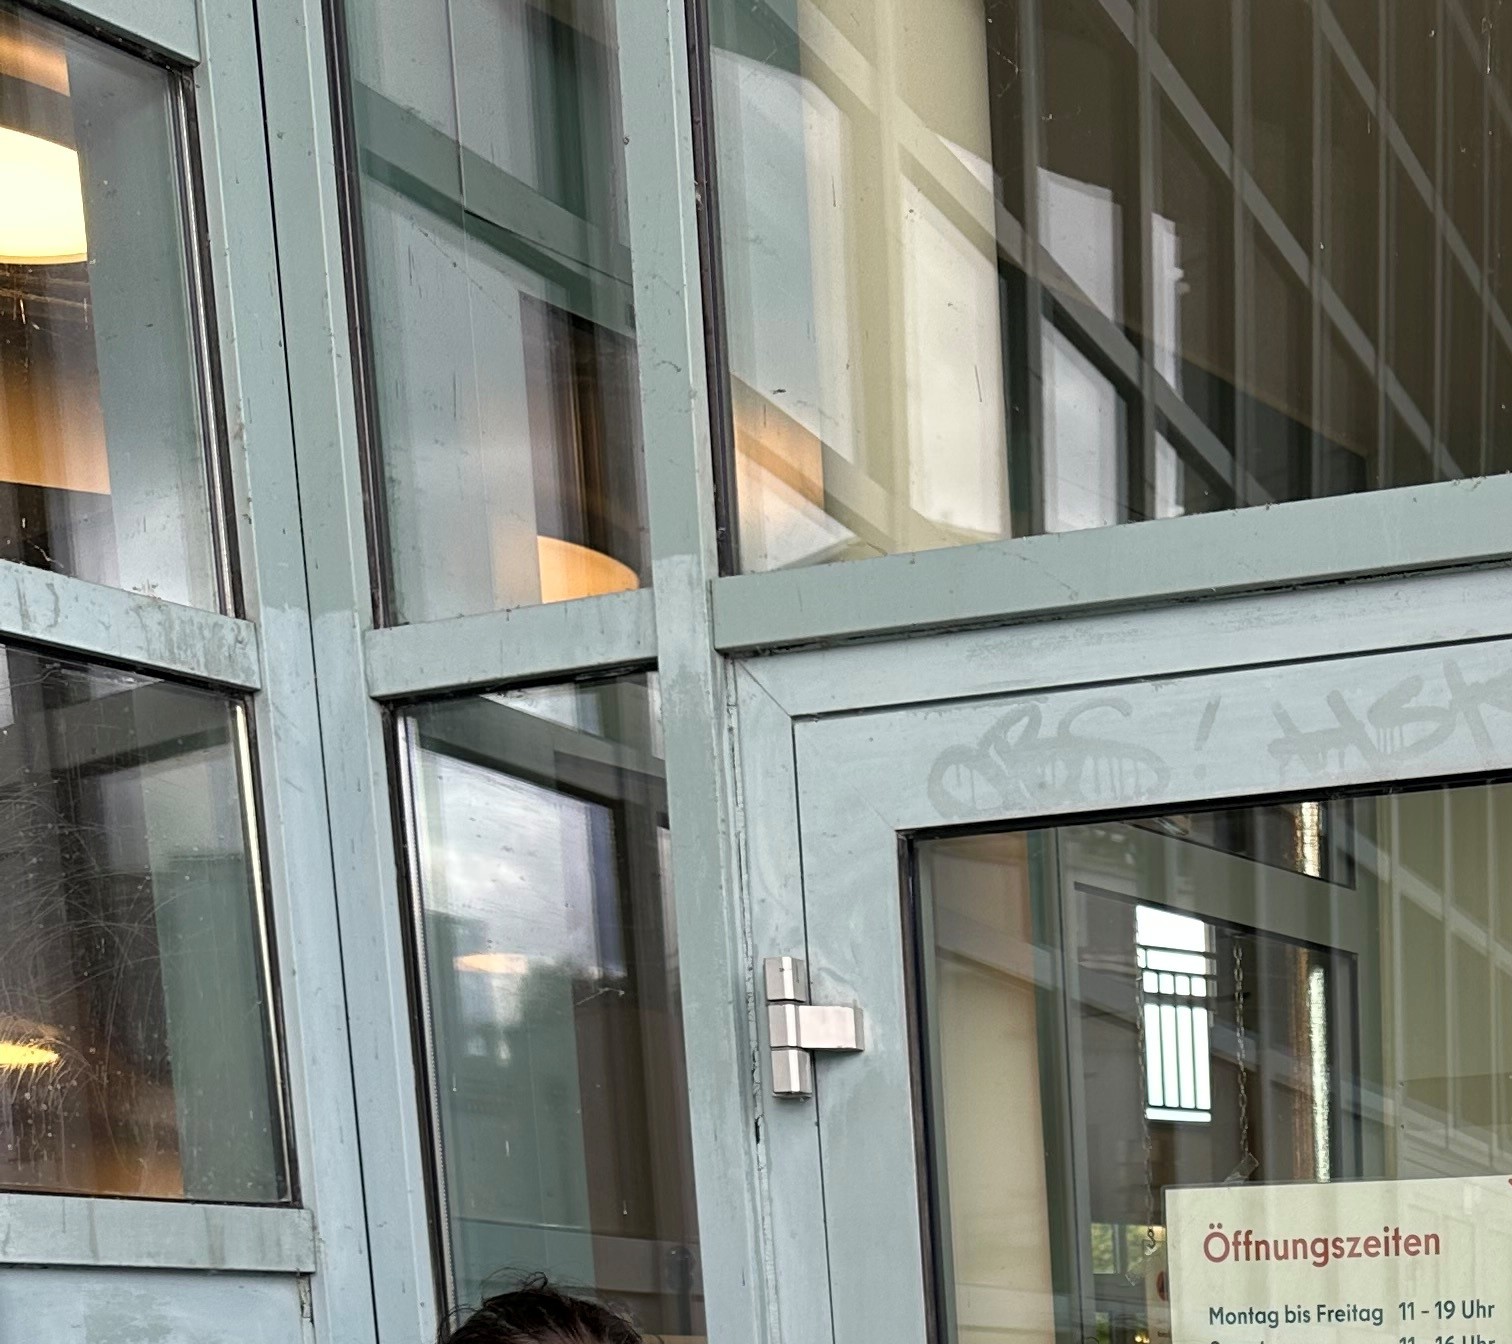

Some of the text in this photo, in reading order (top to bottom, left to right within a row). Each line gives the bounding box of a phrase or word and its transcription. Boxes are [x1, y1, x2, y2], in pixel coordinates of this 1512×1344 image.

[1203, 1222, 1441, 1268] Öffnungszeiten
[1209, 1307, 1279, 1329] Montag
[1285, 1304, 1311, 1324] bis
[1317, 1304, 1384, 1327] Freitag
[1399, 1302, 1415, 1320] 11
[1435, 1300, 1456, 1319] 19
[1462, 1299, 1495, 1319] Uhr
